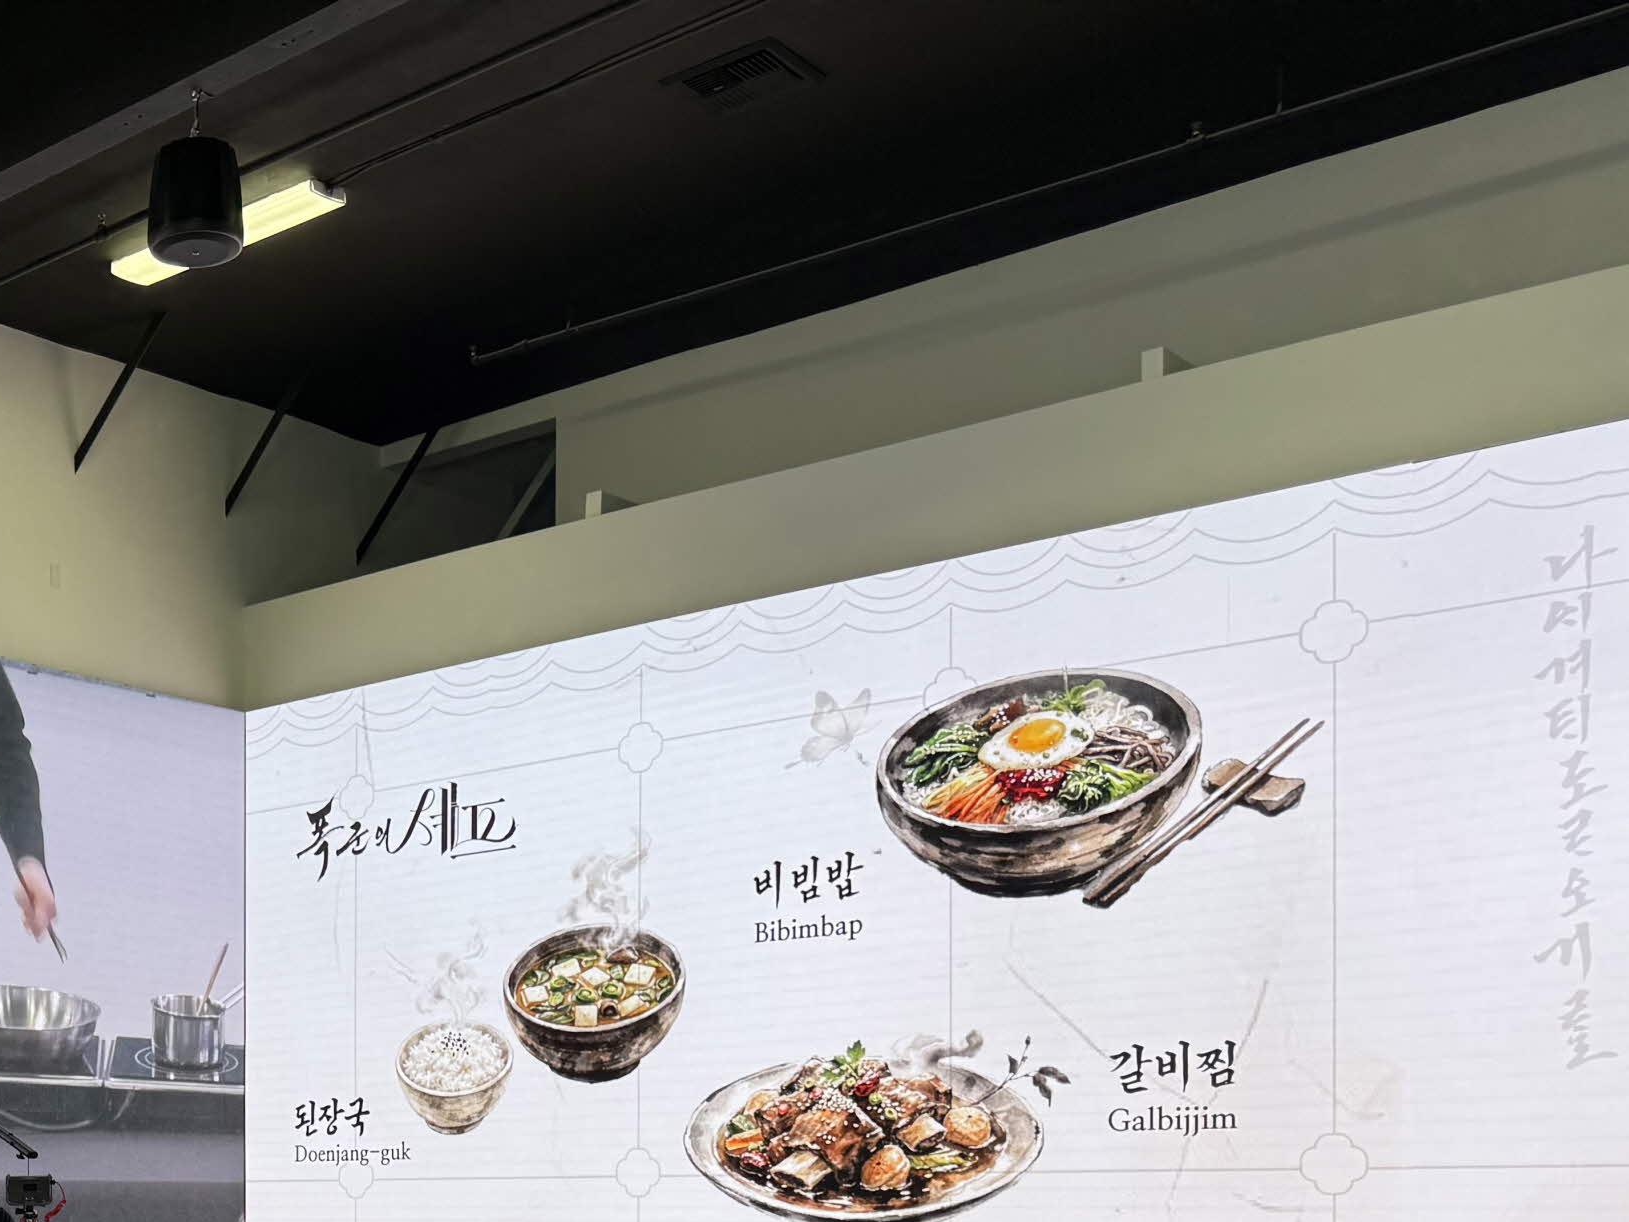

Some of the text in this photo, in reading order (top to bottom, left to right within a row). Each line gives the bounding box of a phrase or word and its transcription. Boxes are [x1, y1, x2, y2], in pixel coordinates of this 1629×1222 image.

[754, 851, 864, 909] 비빔밥
[755, 914, 863, 943] Bibimbap
[1109, 1040, 1236, 1094] 갈비찜
[295, 1097, 370, 1136] 된장국
[1108, 1105, 1237, 1136] Galbijjim
[295, 1141, 411, 1166] Doenjang-guk
